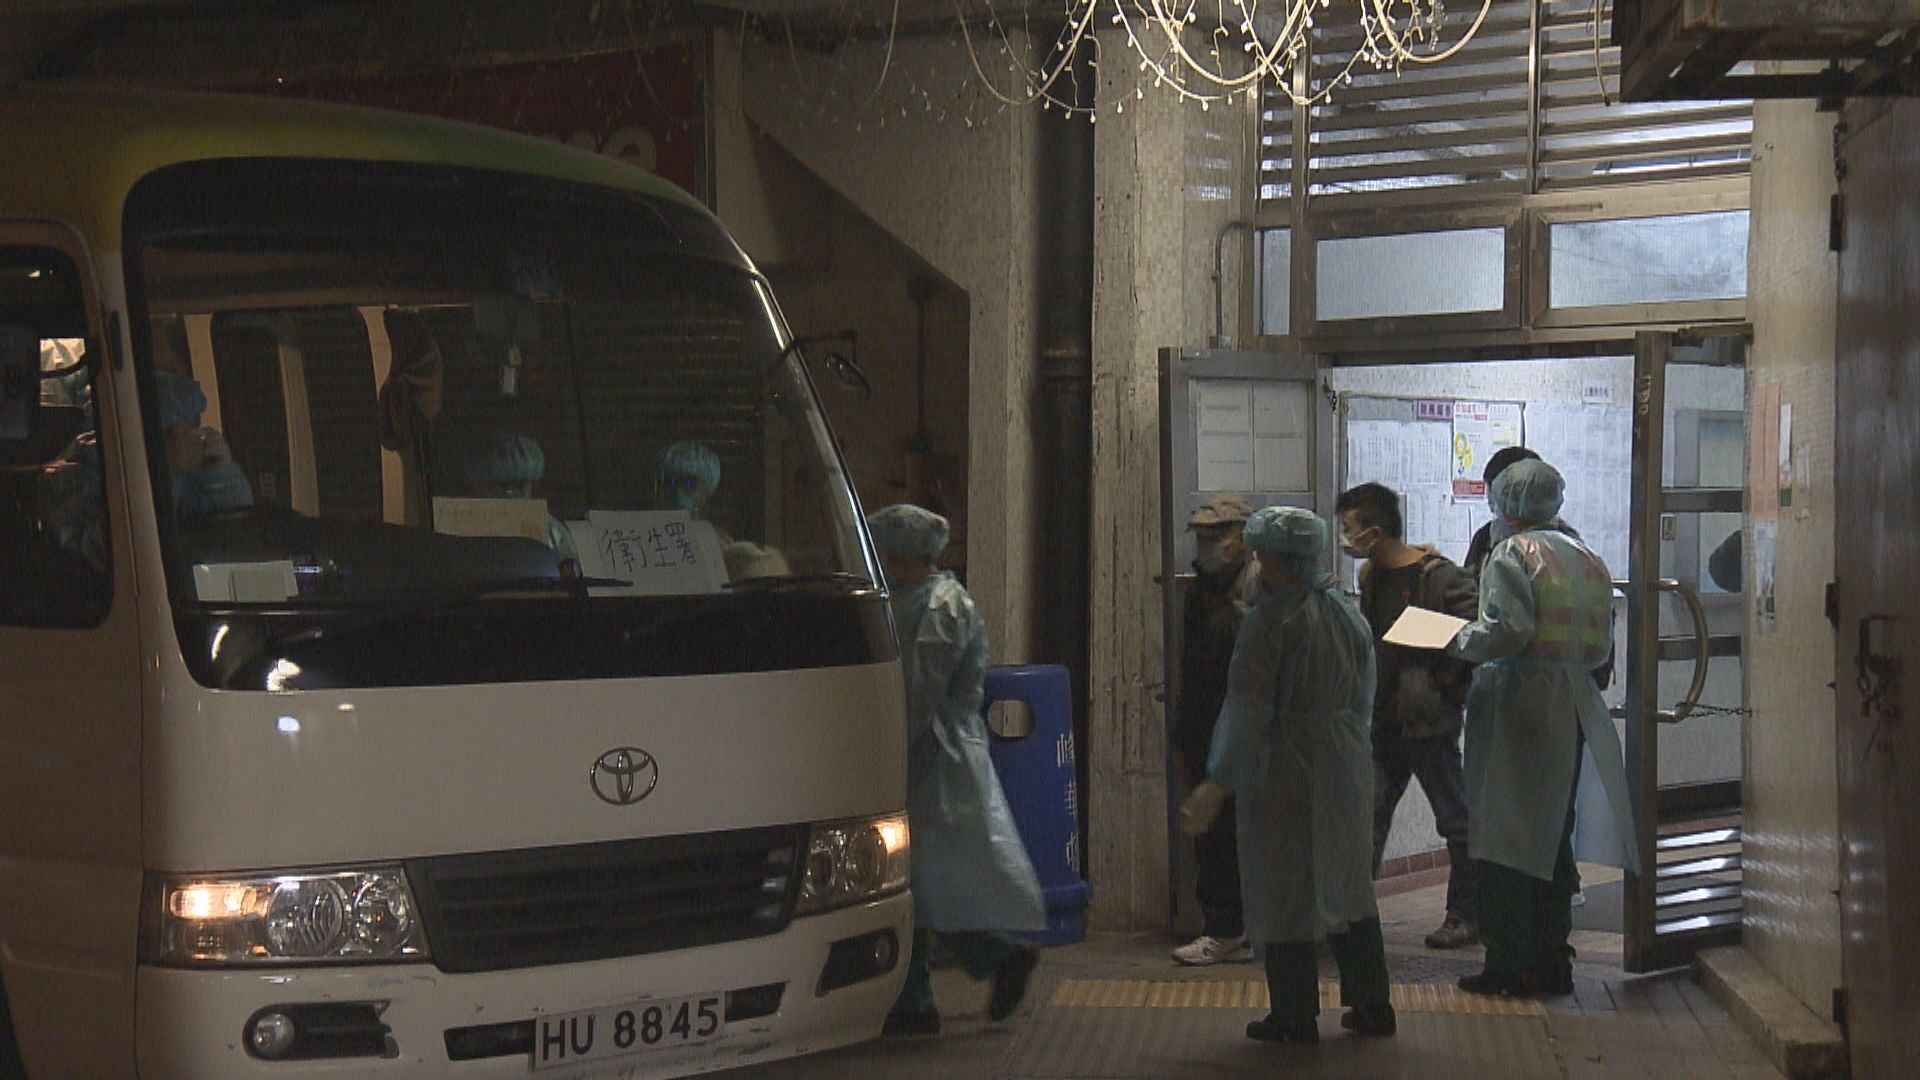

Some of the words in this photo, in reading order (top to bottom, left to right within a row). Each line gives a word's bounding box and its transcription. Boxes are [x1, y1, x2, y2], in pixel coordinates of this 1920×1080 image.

[602, 522, 696, 574] 衛生署
[544, 1017, 594, 1061] HU
[613, 998, 718, 1049] 8845
